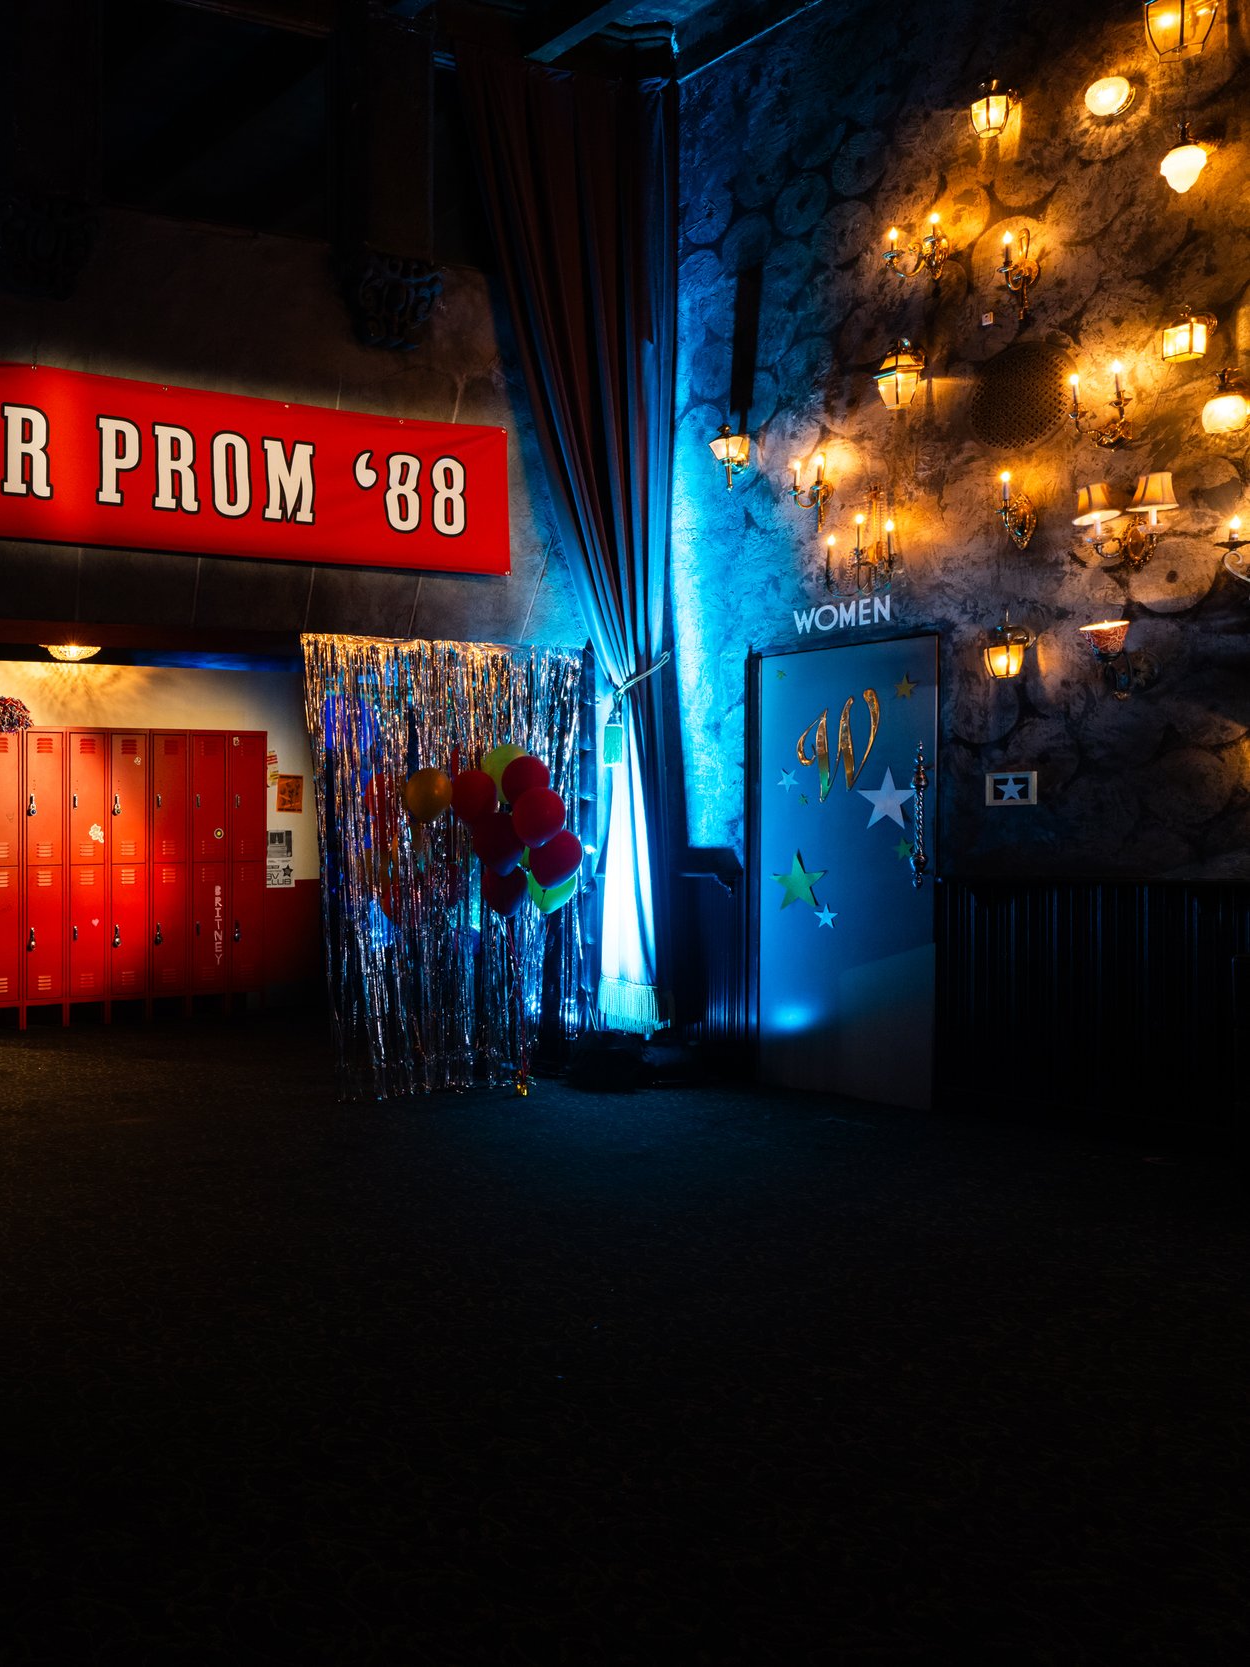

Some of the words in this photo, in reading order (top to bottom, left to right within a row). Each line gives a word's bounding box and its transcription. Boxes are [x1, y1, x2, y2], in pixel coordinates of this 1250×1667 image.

[96, 416, 315, 524] PROM
[793, 595, 891, 634] WOMEN
[214, 885, 223, 966] BRITNEY
